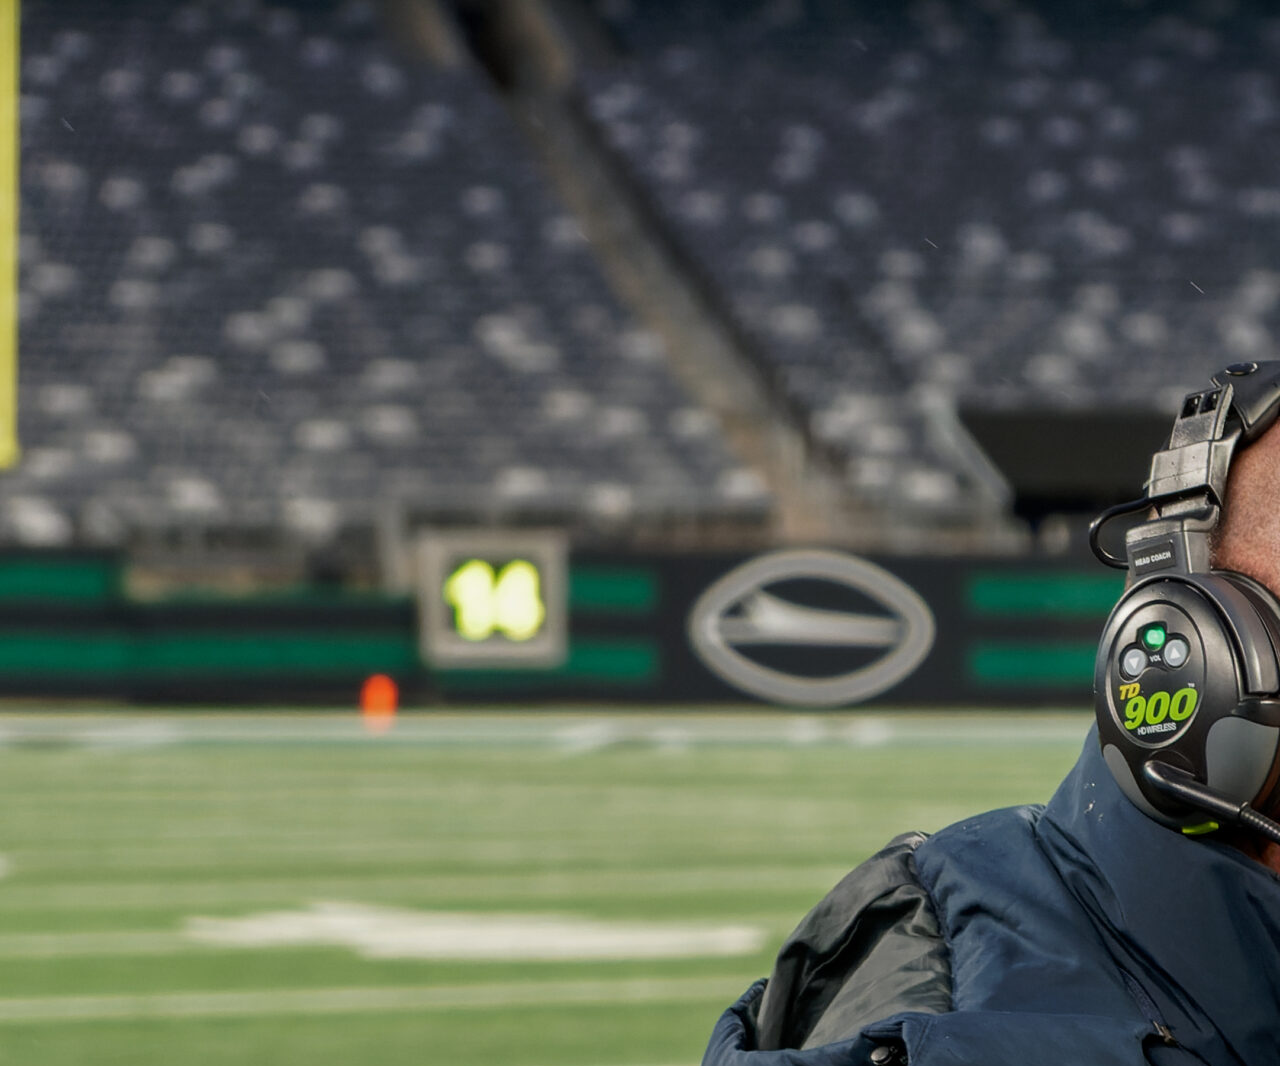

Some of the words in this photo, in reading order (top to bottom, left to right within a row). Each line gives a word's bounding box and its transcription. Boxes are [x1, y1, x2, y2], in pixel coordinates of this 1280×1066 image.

[1135, 556, 1150, 567] HEAD
[1150, 551, 1171, 563] COACH
[1149, 654, 1162, 662] VOL
[1119, 682, 1141, 700] TD
[1124, 687, 1198, 730] 900
